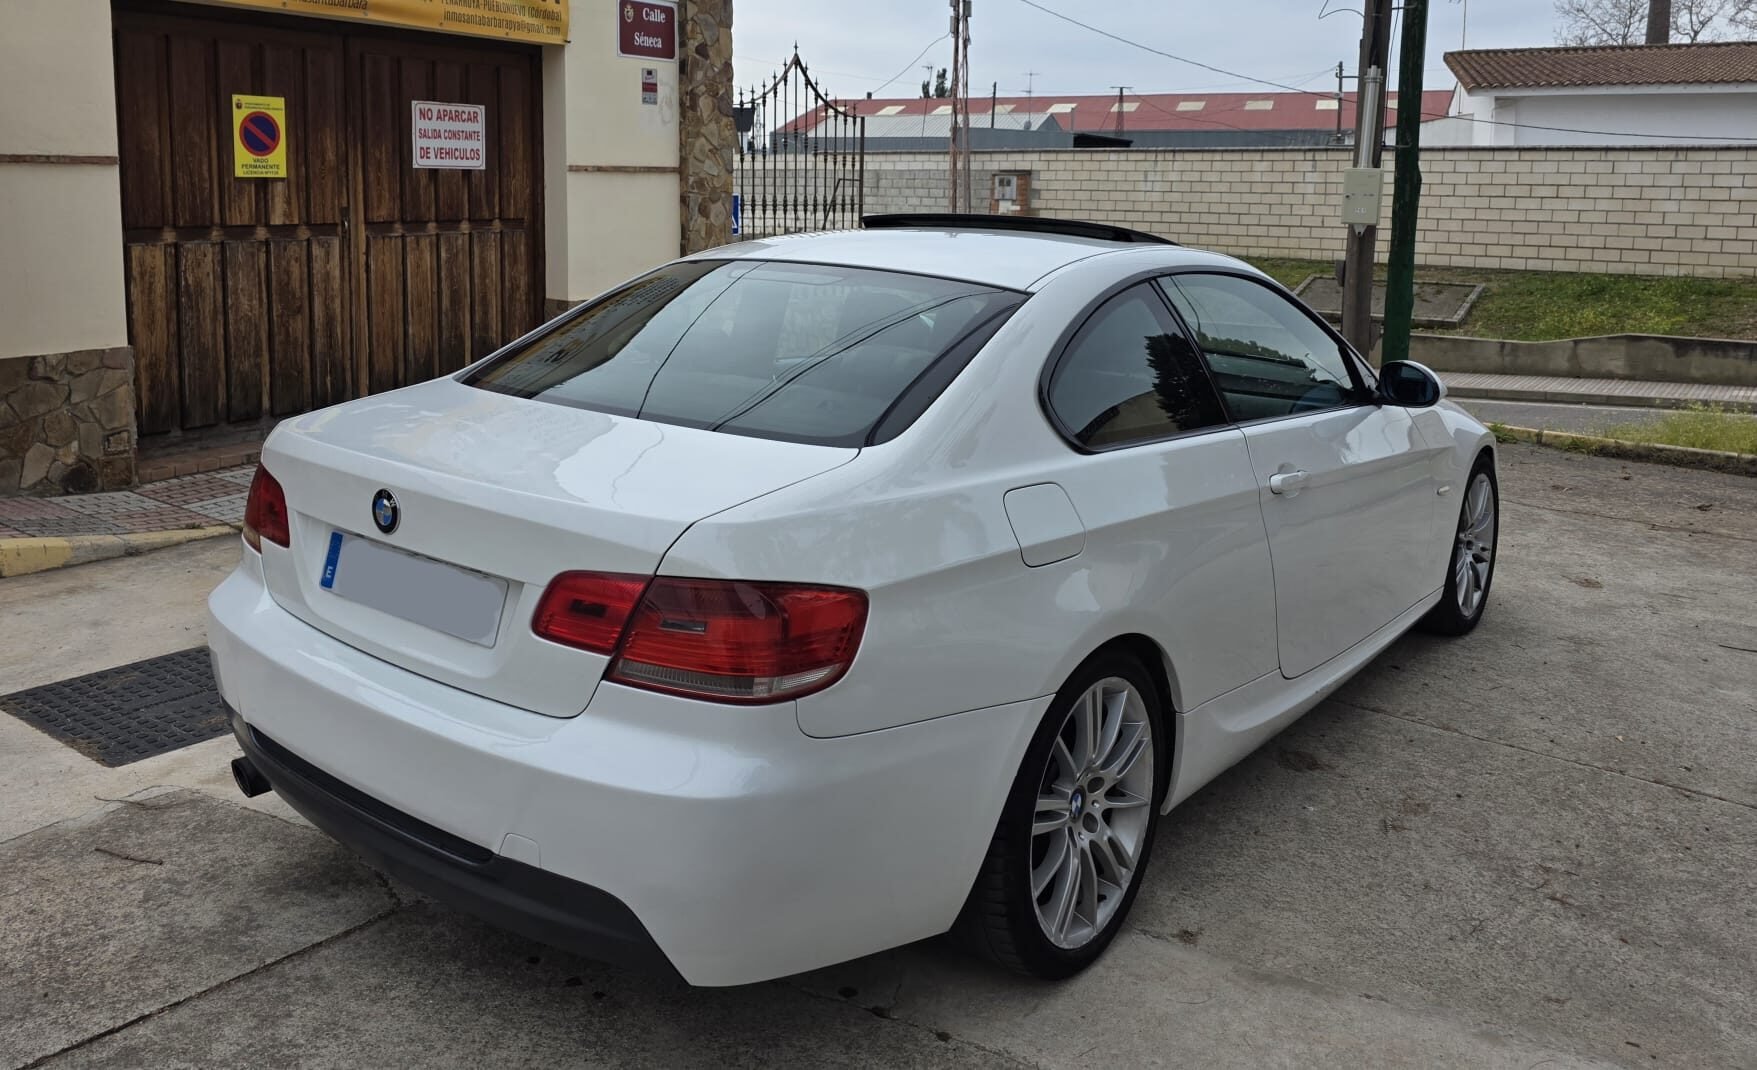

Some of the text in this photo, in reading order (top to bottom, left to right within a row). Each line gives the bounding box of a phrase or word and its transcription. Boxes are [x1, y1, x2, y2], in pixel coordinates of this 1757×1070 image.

[643, 8, 665, 22] Calle
[634, 32, 662, 48] Séneca
[419, 108, 479, 123] NO APARCAR
[419, 128, 480, 141] SALIDA CONSTANTE
[420, 147, 480, 160] DE VEHICULOS
[325, 566, 333, 578] E
